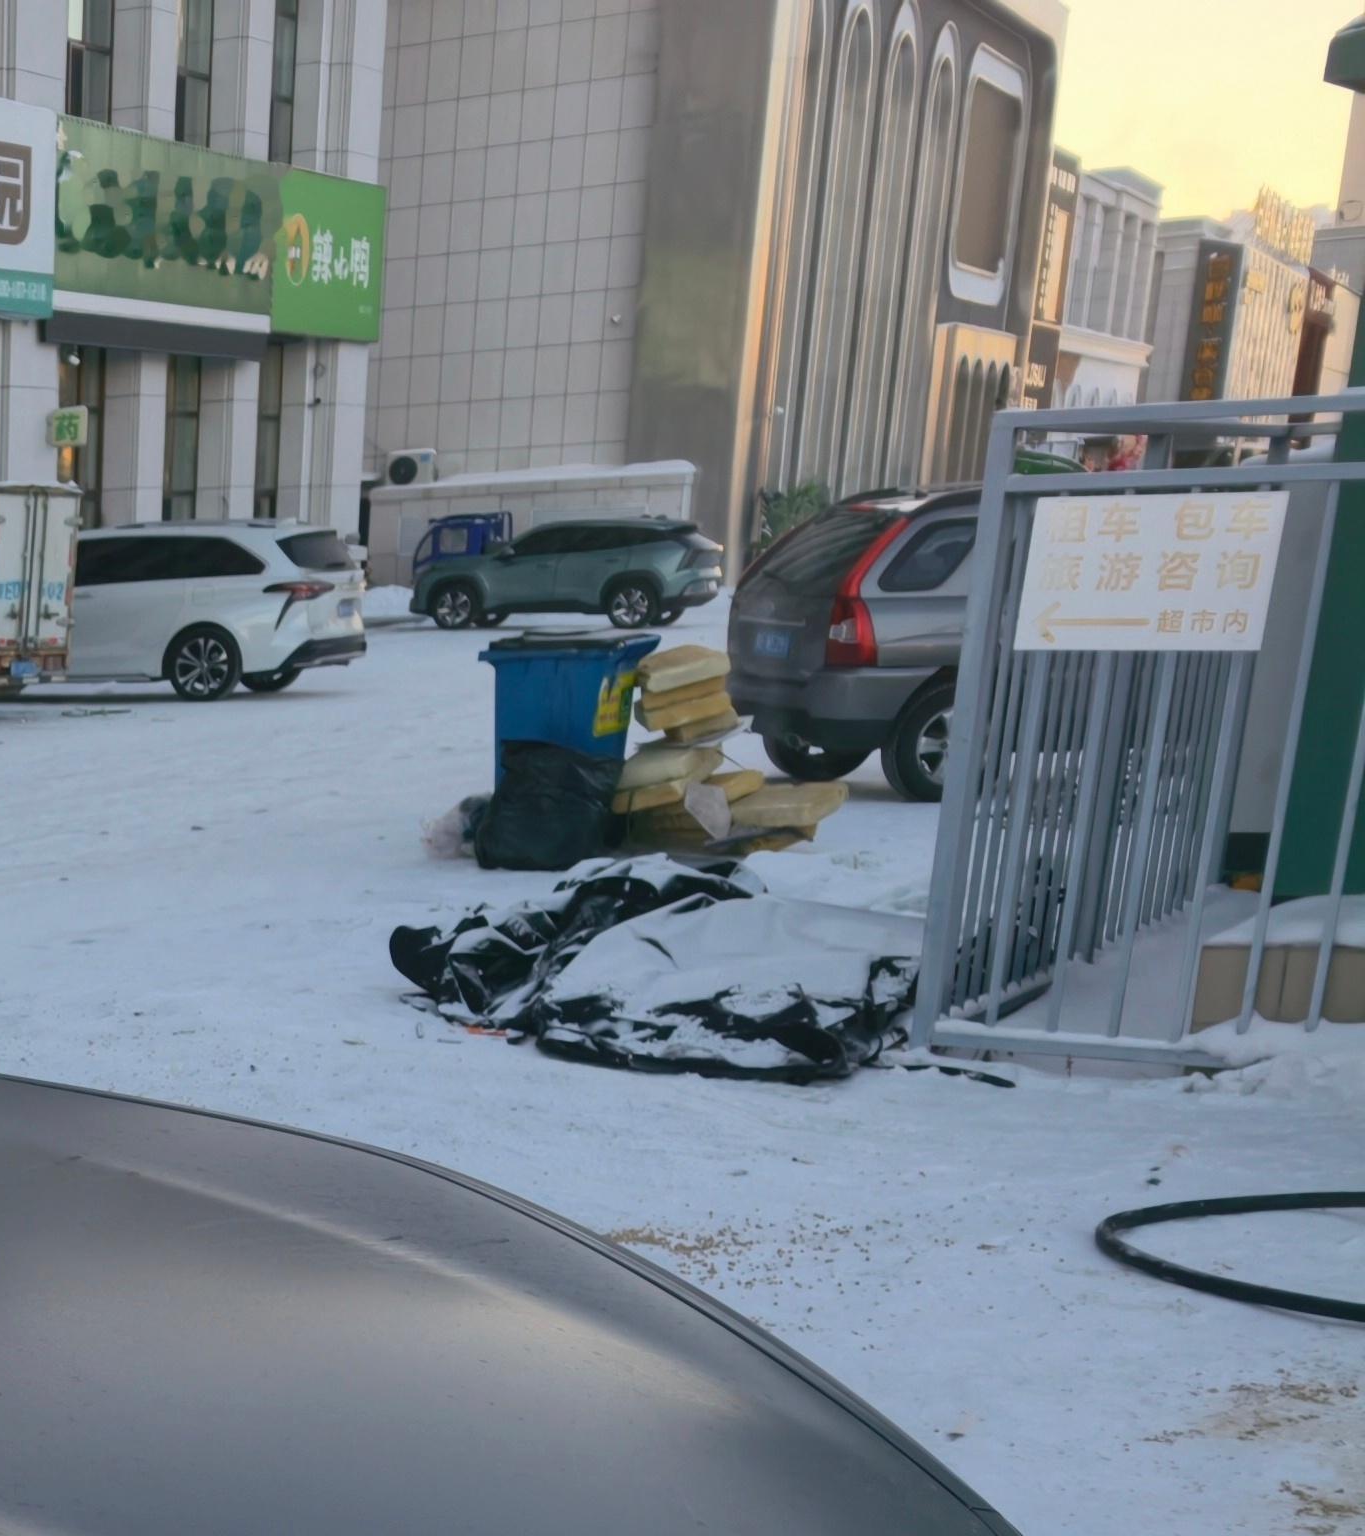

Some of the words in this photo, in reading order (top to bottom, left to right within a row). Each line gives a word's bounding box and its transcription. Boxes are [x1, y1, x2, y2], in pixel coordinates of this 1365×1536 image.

[1174, 499, 1273, 541] 包车
[1040, 550, 1261, 592] 旅游咨询
[1156, 609, 1248, 634] 超市内
